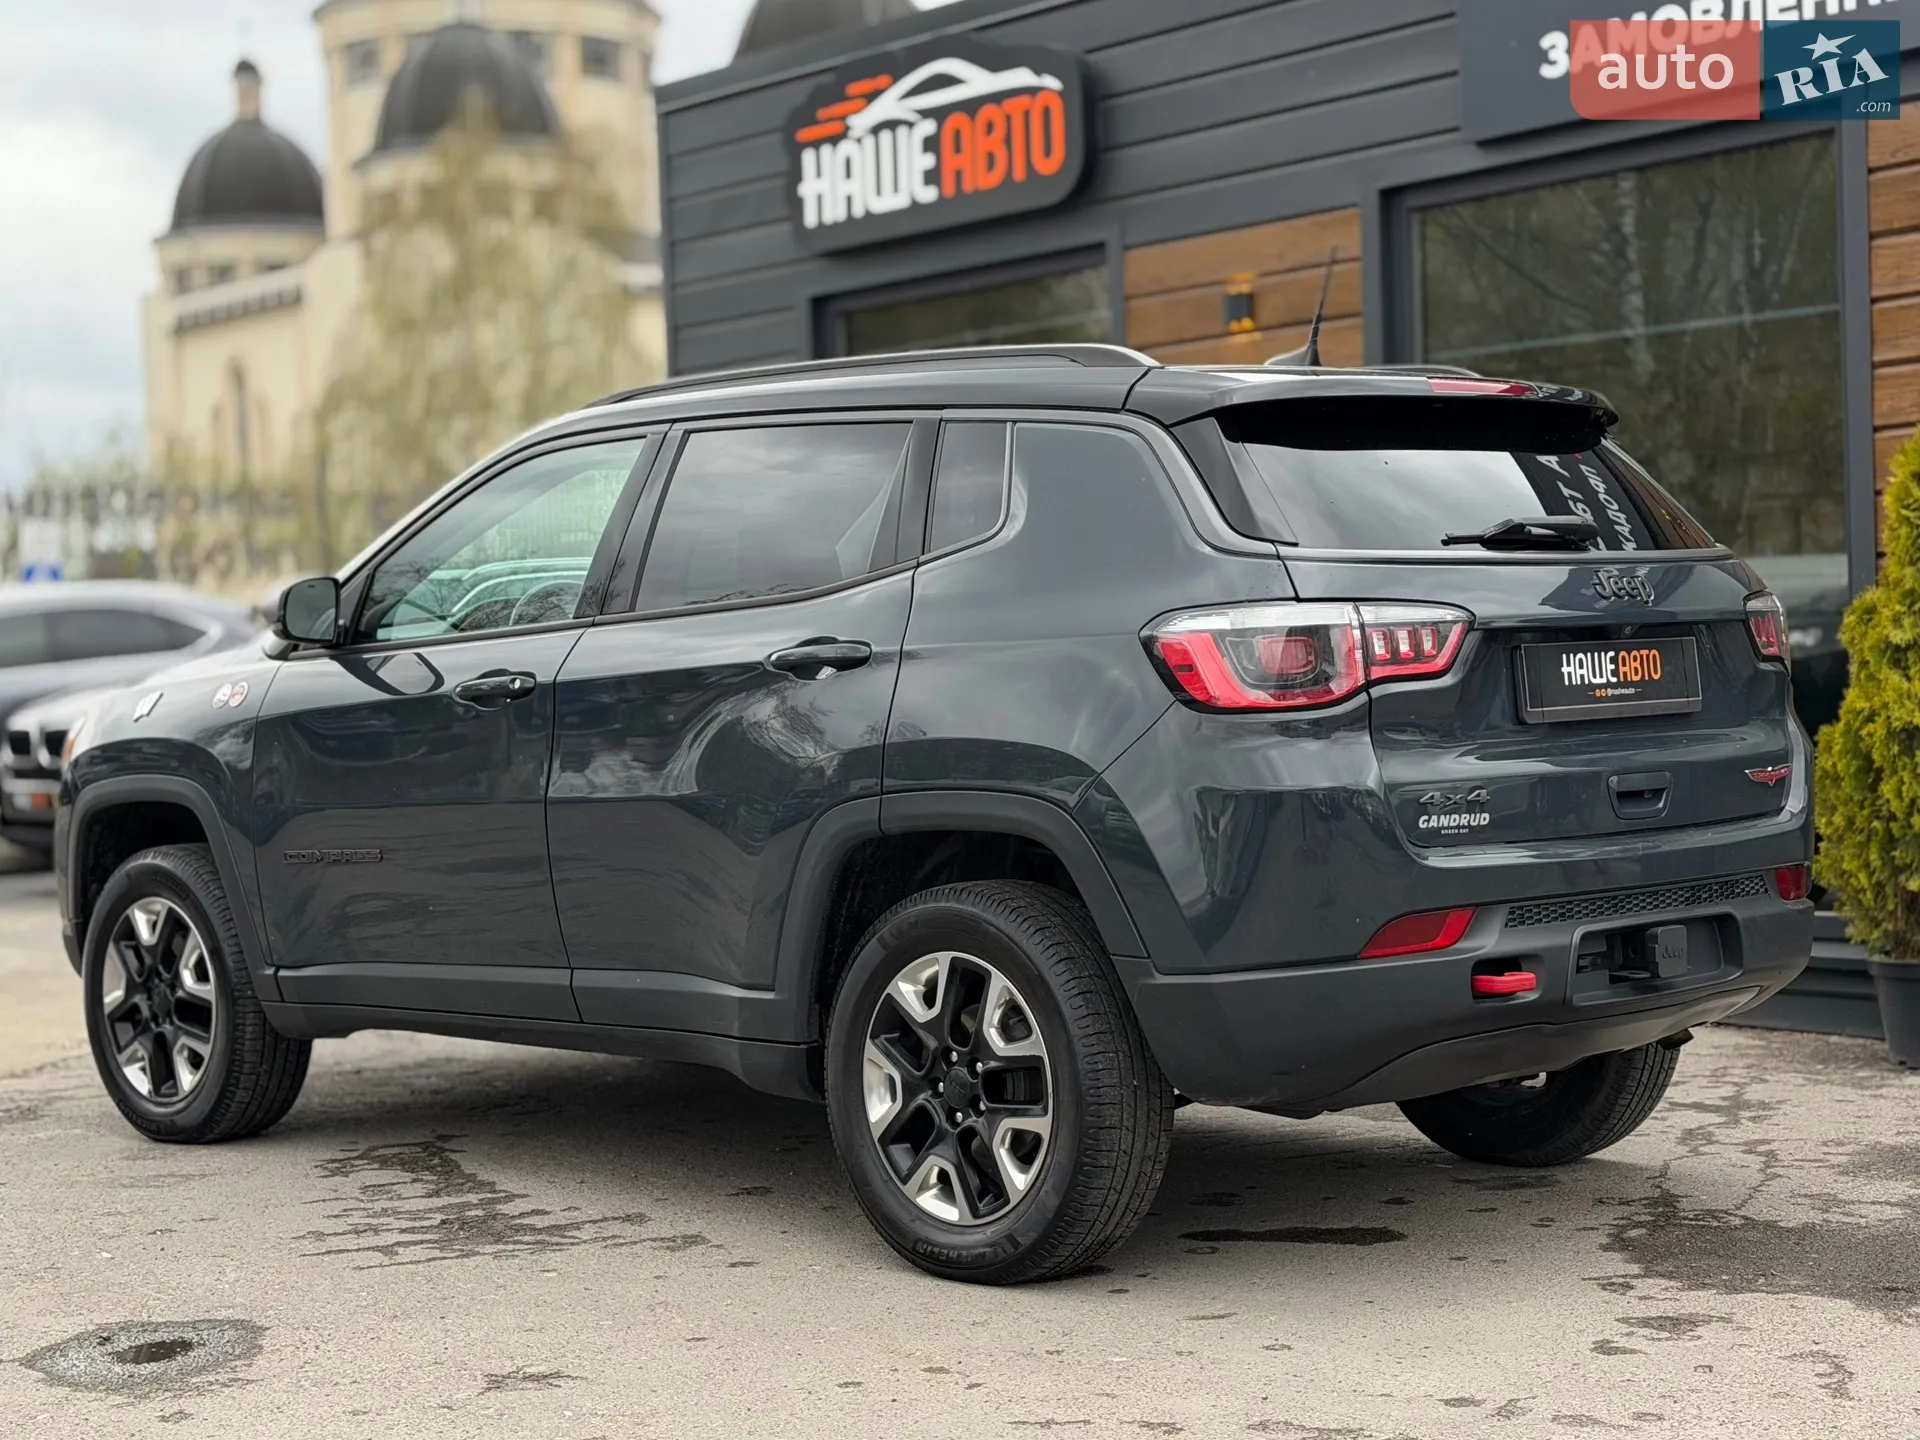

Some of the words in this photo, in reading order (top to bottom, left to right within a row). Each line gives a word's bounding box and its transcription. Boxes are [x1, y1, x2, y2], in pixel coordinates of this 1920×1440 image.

[797, 117, 940, 230] НАШЕ
[940, 89, 1066, 199] АВТО
[1592, 567, 1655, 606] Jeep
[1561, 651, 1618, 686] НАШЕ
[1618, 649, 1662, 682] АВТО
[1419, 789, 1491, 807] 4x4
[1418, 812, 1490, 829] GANDRUD
[283, 848, 383, 864] COMPASS
